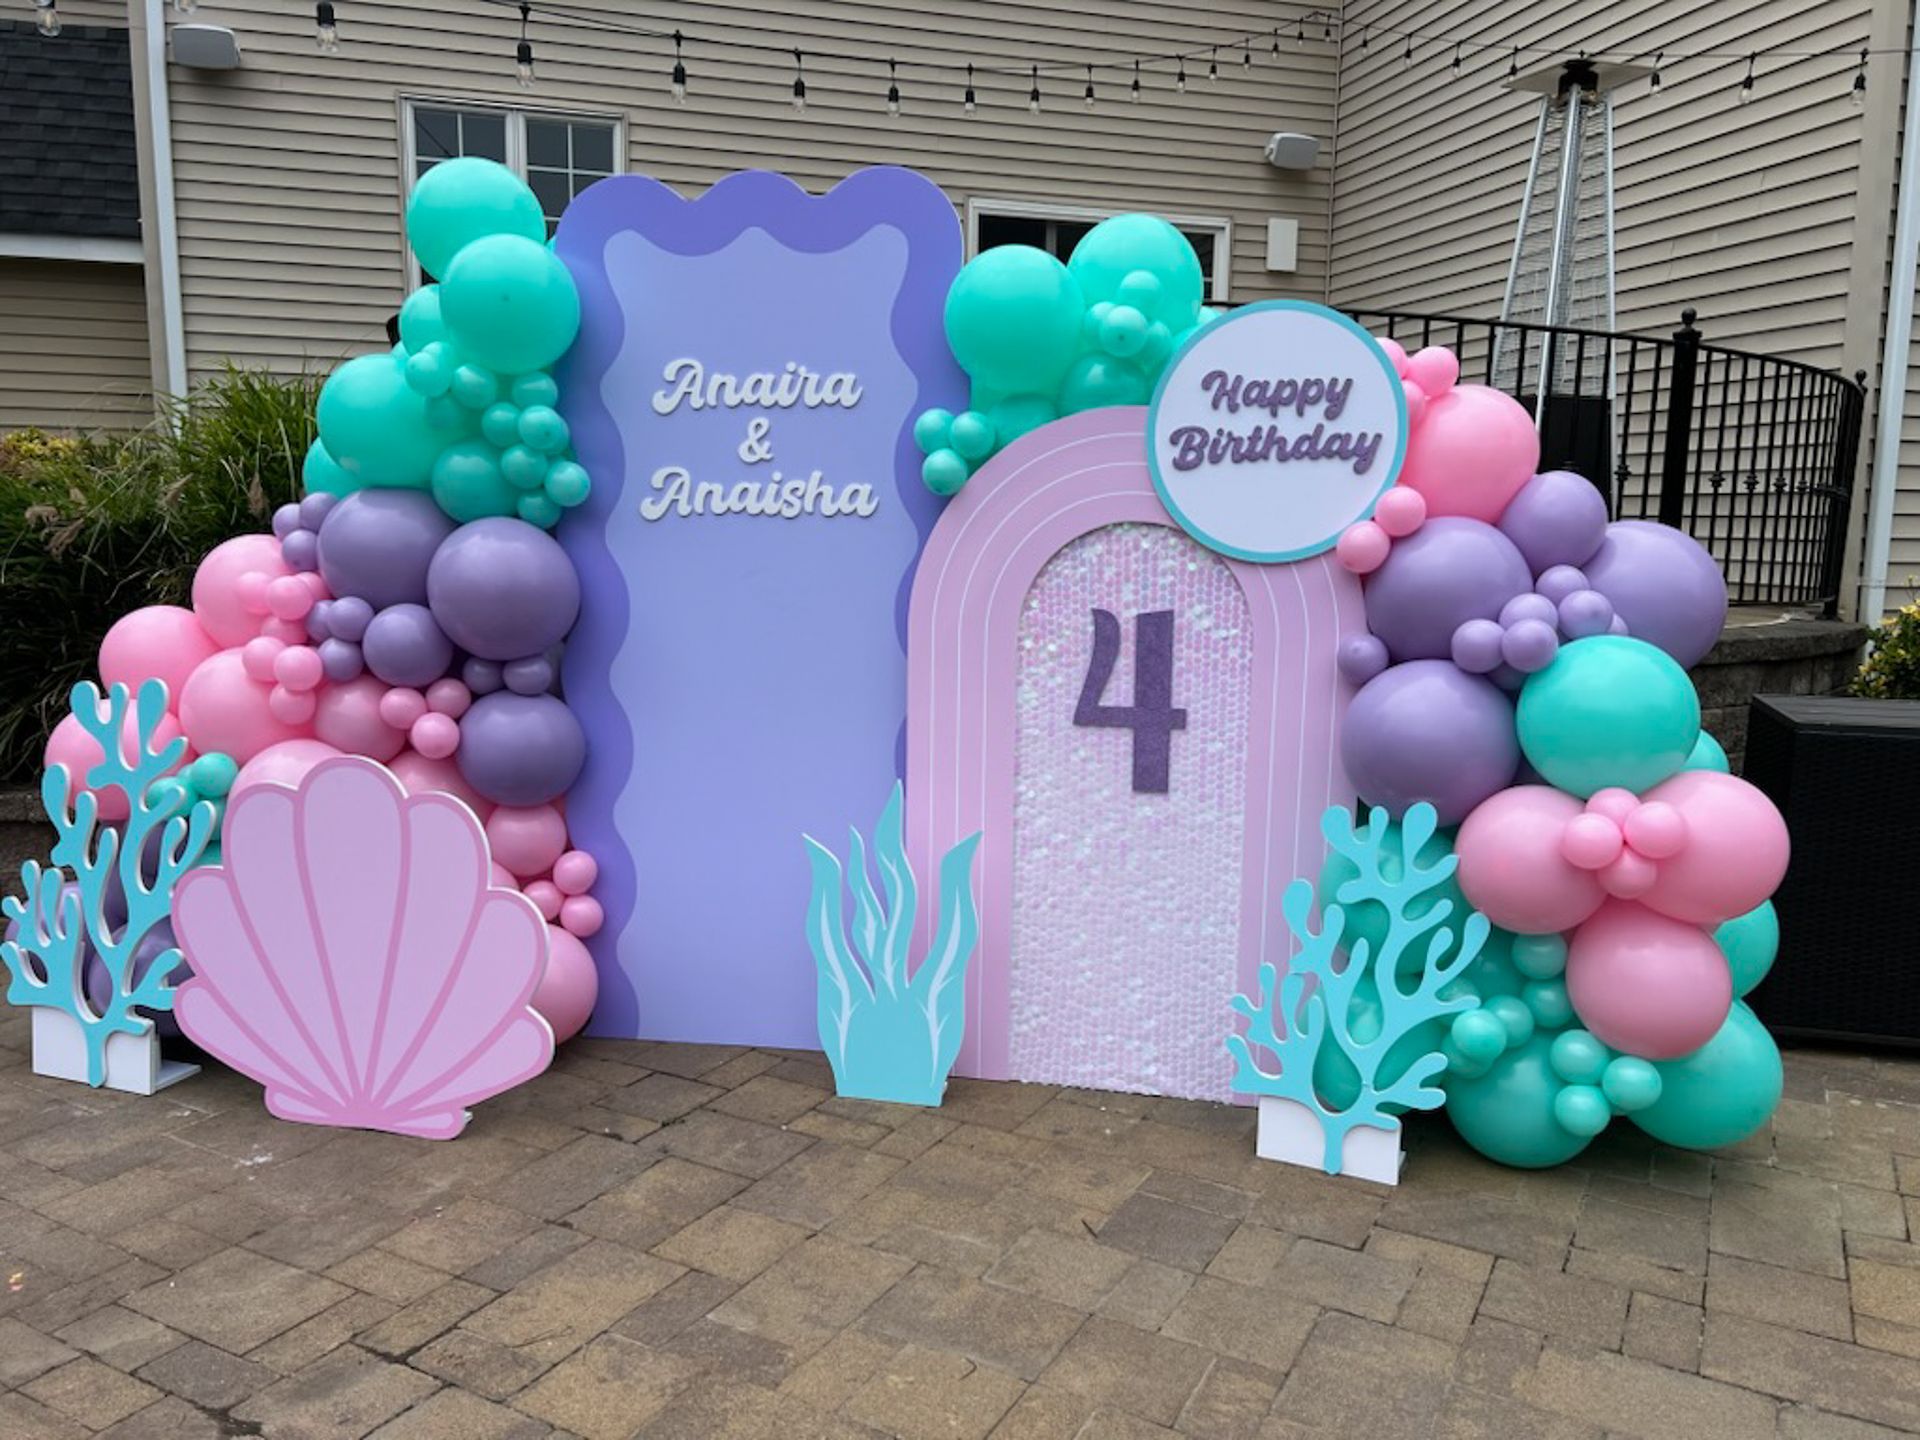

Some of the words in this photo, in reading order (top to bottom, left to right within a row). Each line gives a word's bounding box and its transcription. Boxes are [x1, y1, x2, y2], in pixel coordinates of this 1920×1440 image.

[651, 358, 863, 415] Anaira
[1201, 370, 1353, 421] Happy
[737, 416, 774, 464] &
[1169, 423, 1383, 475] Birthday
[640, 466, 879, 521] Anaisha
[1073, 608, 1187, 793] 4
